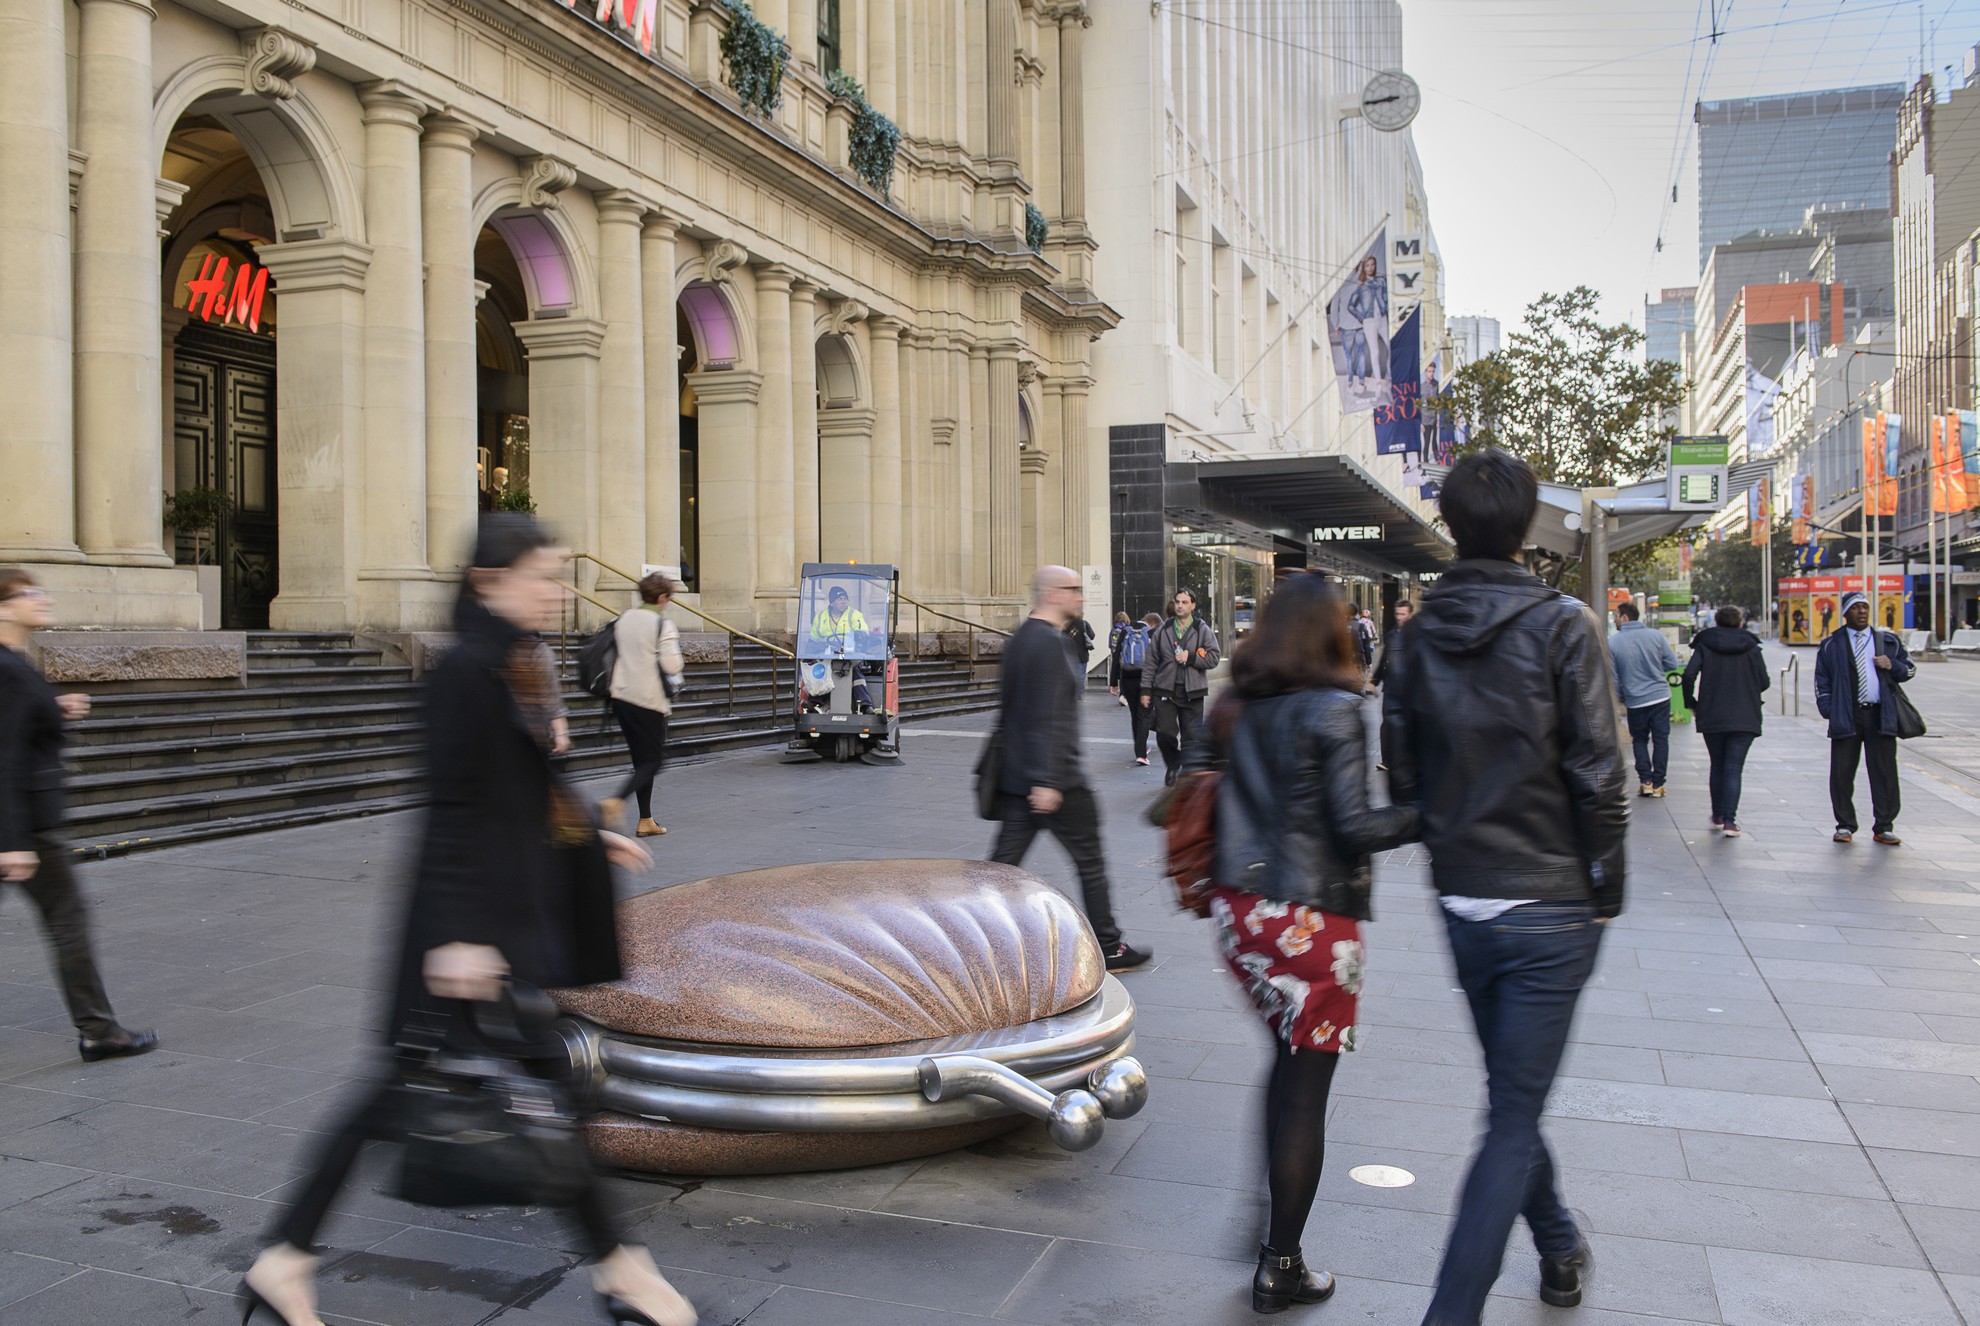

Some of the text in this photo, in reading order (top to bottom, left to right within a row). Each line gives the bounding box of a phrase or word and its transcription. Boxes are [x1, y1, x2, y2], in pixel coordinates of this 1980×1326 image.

[188, 253, 269, 334] H&M
[1396, 239, 1420, 323] MY
[1375, 396, 1418, 425] 360
[1314, 526, 1380, 540] MYER
[1419, 572, 1443, 581] MY
